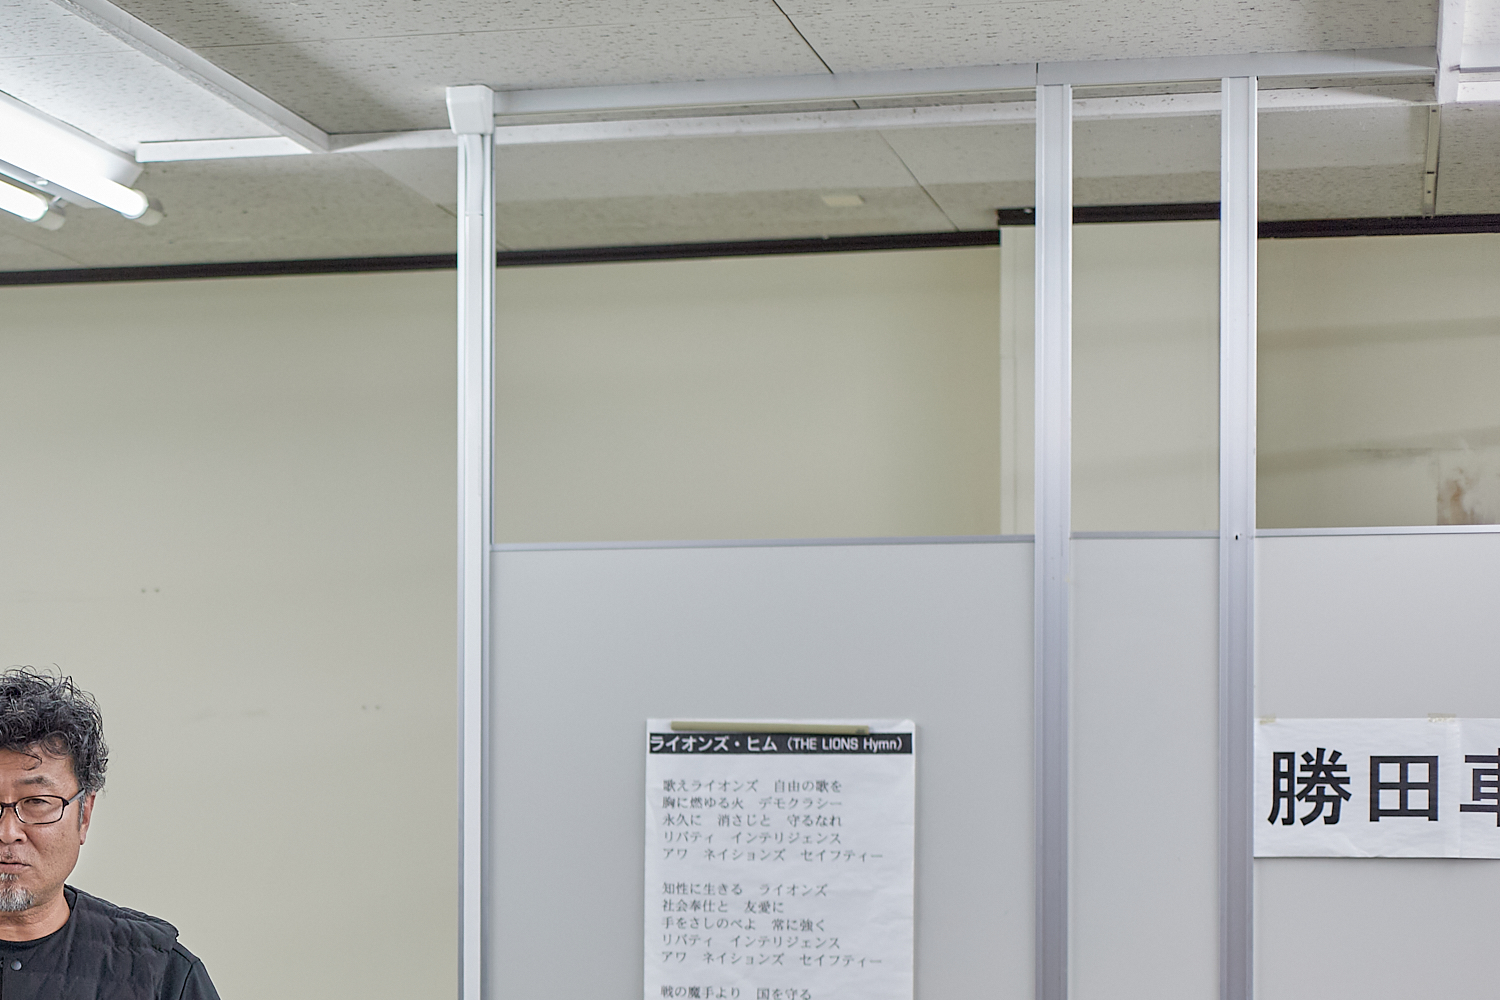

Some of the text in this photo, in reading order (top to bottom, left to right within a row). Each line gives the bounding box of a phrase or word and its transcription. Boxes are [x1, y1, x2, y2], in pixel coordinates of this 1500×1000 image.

[650, 736, 778, 751] ライオンズ・ヒム
[822, 737, 858, 750] LIONS
[663, 779, 842, 792] 歌えライオンズ 自由の歌を
[662, 796, 842, 810] 胸に燃ゆる火 デモクラシー
[662, 814, 842, 827] 永久に 消さじと 守るなれ
[731, 832, 842, 844] インテリジェンス
[662, 848, 884, 862] アワ ネイションズ セイフティー
[662, 882, 828, 896] 知性に生きる ライオンズ
[662, 899, 784, 914] 社会奉仕と 友愛に
[662, 917, 826, 932] 手をさしのべよ 常に強く
[730, 936, 840, 948] インテリジェンス
[662, 952, 882, 968] アワ ネイションズ セイフティー
[661, 986, 812, 1000] 戦の魔手より 国を守る
